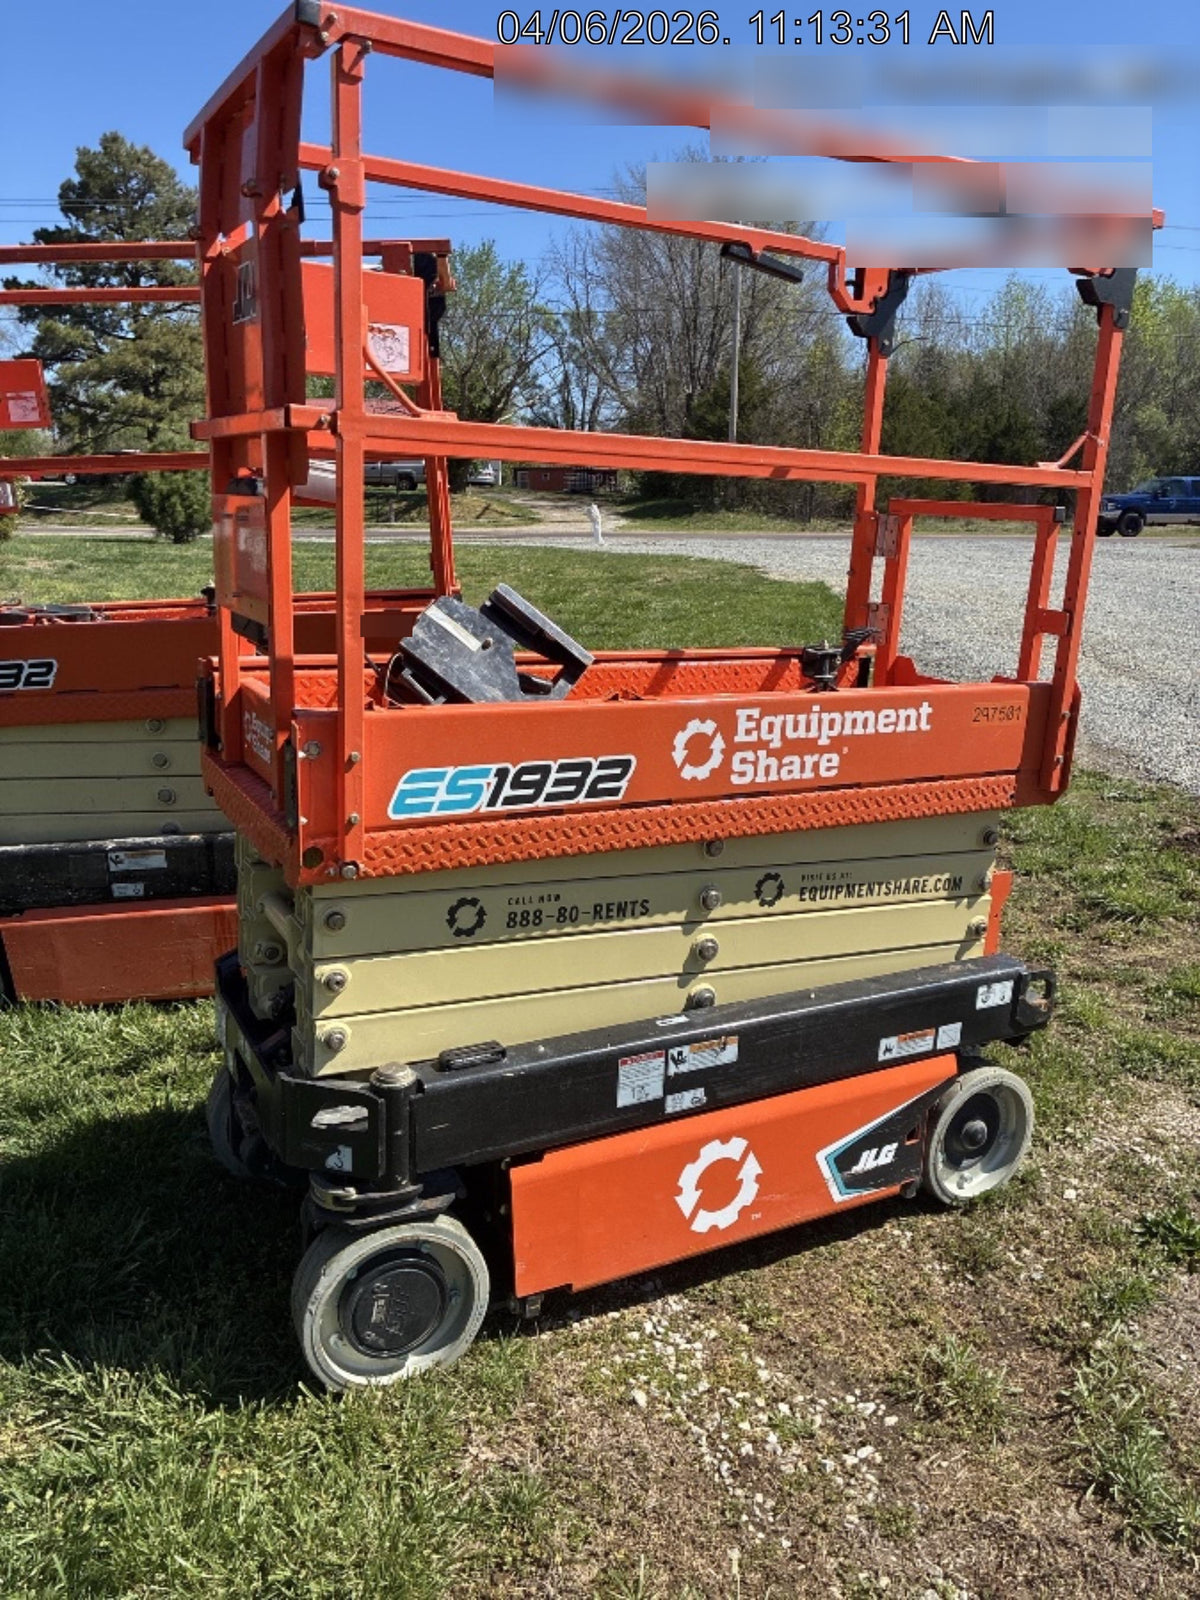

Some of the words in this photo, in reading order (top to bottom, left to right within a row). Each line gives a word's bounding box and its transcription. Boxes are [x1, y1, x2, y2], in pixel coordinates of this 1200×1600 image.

[734, 702, 933, 748] Equipment
[971, 704, 1023, 723] 297501
[729, 750, 841, 785] Share
[389, 755, 636, 818] ES1932
[507, 896, 534, 906] CALL
[538, 893, 561, 904] NOW
[799, 876, 963, 903] EQUIPMENTSHARE.COM
[506, 899, 651, 929] 888-80-RENTS
[850, 1142, 899, 1174] JLG
